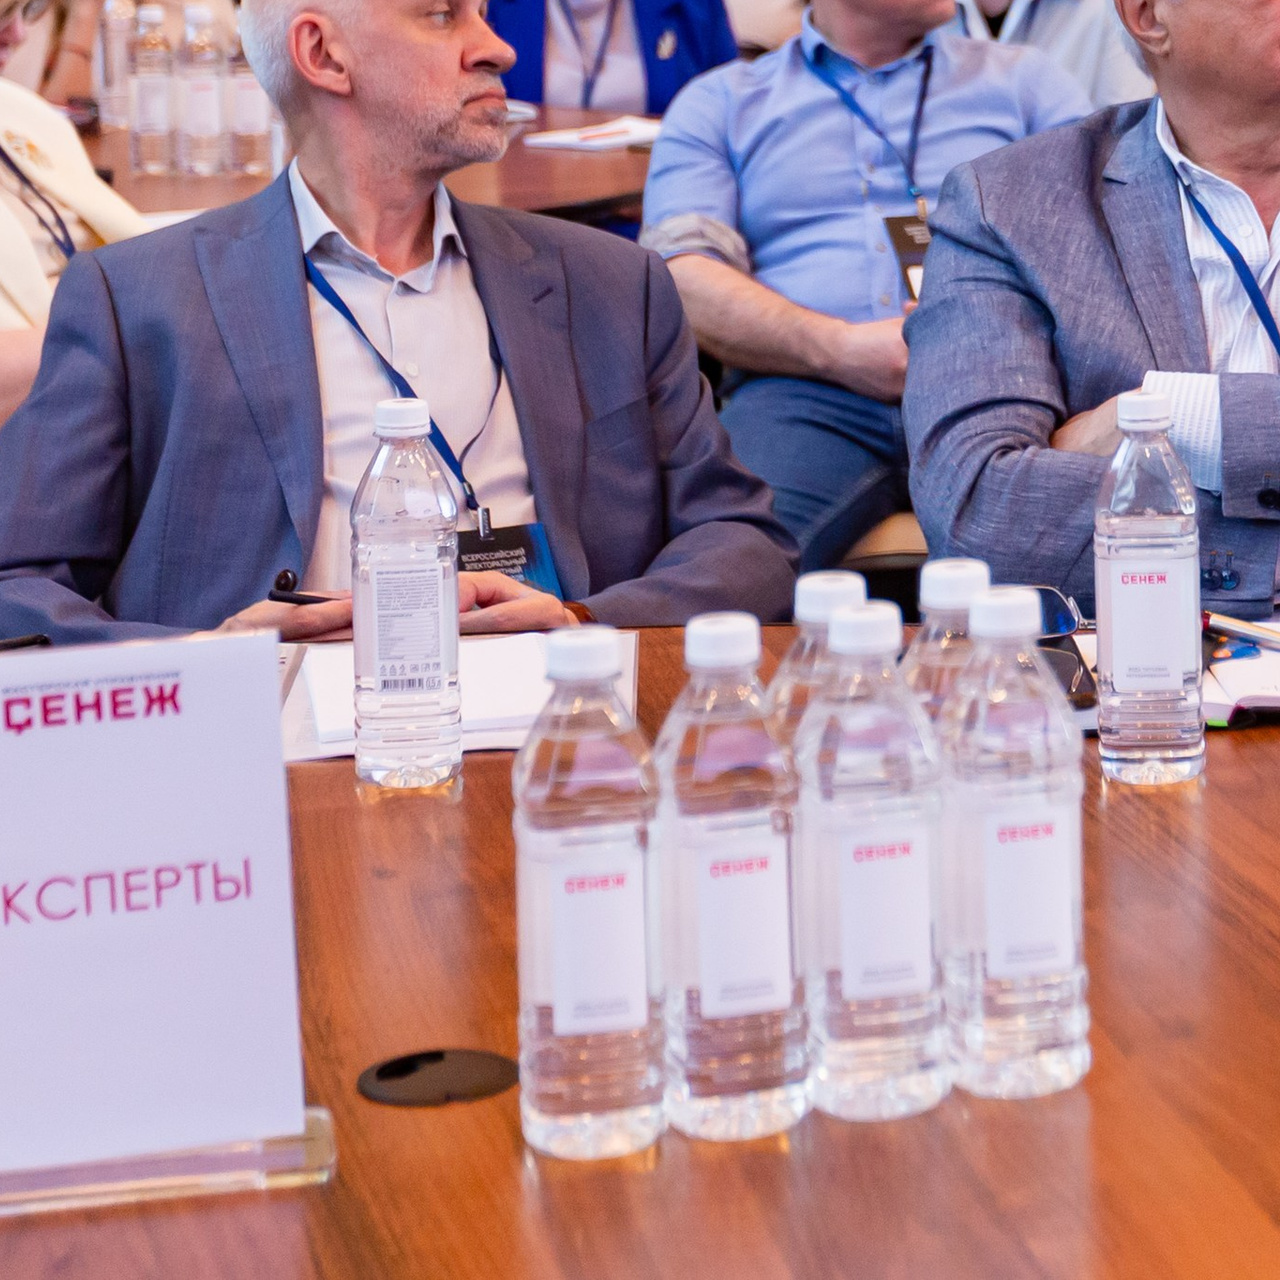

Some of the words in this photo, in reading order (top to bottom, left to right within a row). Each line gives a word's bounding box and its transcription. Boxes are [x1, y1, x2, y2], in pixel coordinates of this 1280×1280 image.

[1121, 574, 1167, 585] СЕНЕЖ
[3, 683, 181, 735] СЕНЕЖ
[1, 856, 252, 925] КСПЕРТЫ
